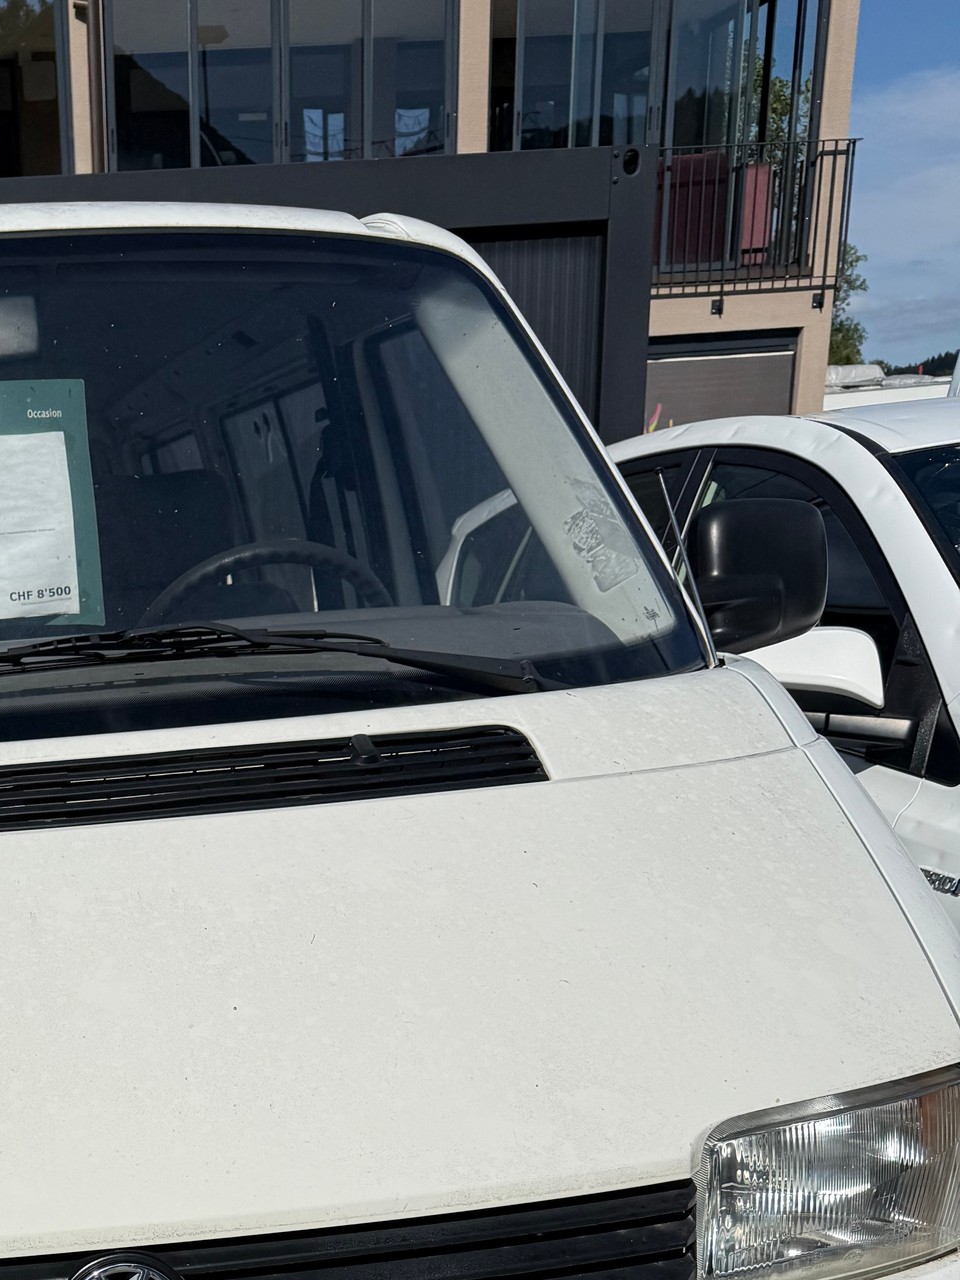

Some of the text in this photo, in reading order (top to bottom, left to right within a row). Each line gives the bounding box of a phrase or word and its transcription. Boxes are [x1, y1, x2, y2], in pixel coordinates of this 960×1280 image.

[26, 408, 62, 419] Occasion
[9, 590, 33, 602] CHF
[37, 585, 71, 599] 8'500
